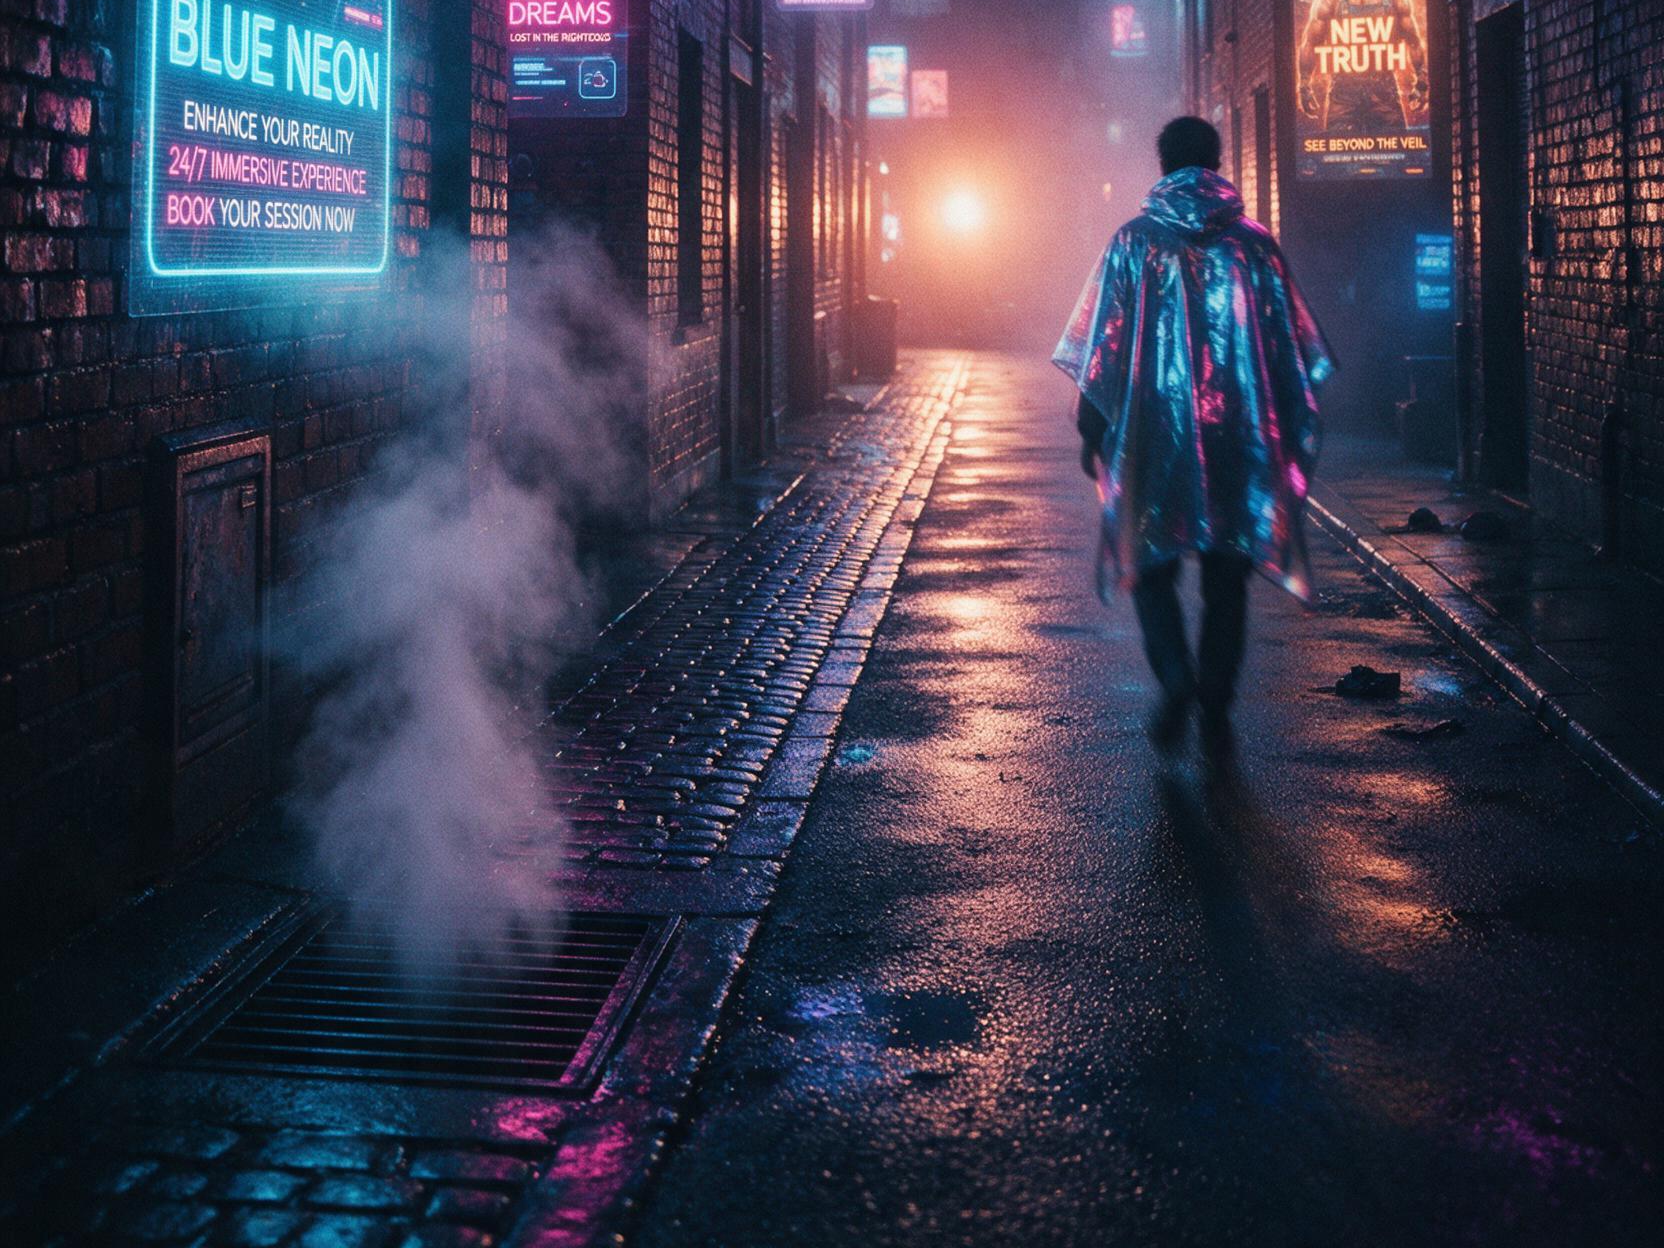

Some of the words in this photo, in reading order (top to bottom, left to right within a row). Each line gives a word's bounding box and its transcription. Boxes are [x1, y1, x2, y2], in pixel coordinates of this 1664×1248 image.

[509, 2, 611, 25] DREAMS
[510, 33, 530, 42] LOST
[533, 33, 540, 42] IN
[543, 33, 559, 42] THE
[1330, 16, 1394, 44] NEW
[286, 25, 379, 110] NEON
[1314, 42, 1406, 74] TRUTH
[184, 100, 257, 141] ENHANCE
[261, 118, 299, 145] YOUR
[303, 124, 354, 155] REALITY
[1304, 138, 1326, 152] SEE
[1329, 137, 1374, 152] BEYOND
[1376, 137, 1397, 149] THE
[168, 146, 207, 182] 24/7
[211, 151, 288, 186] IMMERSIVE
[292, 161, 366, 194] EXPERIENCE
[167, 195, 215, 225] BOOK
[219, 198, 260, 227] YOUR
[264, 201, 321, 230] SESSION
[325, 207, 355, 232] NOW
